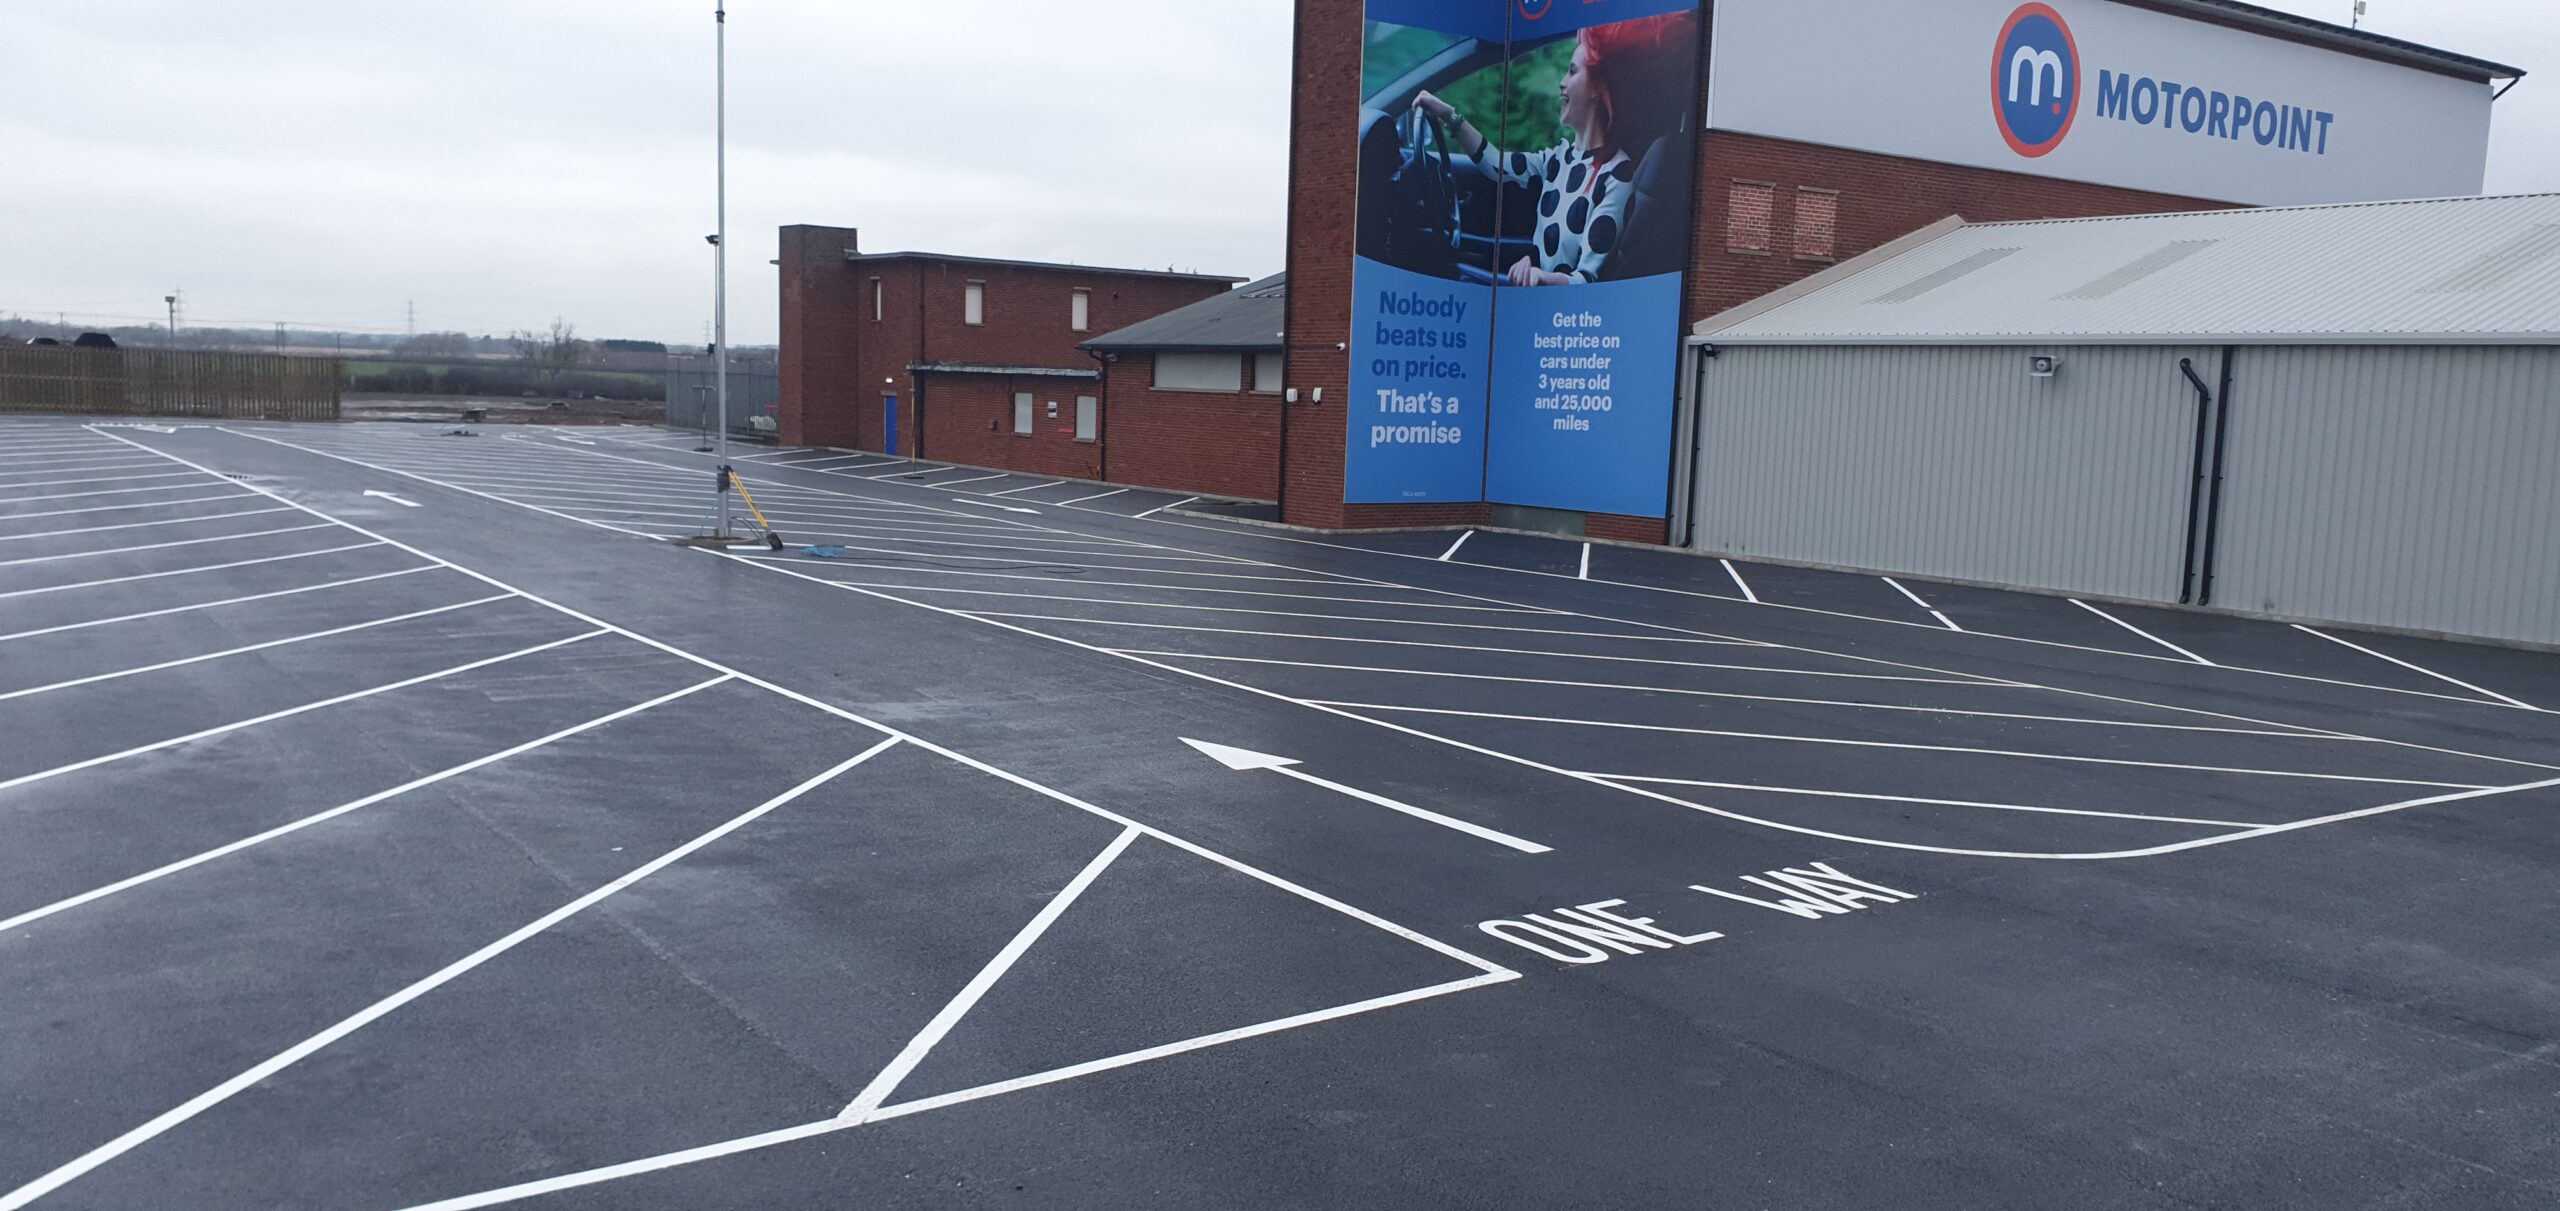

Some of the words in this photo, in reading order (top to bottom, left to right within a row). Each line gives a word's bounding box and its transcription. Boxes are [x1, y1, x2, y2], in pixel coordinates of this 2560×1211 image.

[2096, 68, 2333, 155] MOTORPOINT
[1379, 290, 1467, 324] Nobody
[1552, 311, 1577, 328] Get
[1578, 310, 1602, 328] the
[1375, 320, 1438, 348] beats
[1441, 330, 1467, 349] us
[1533, 332, 1562, 349] best
[1563, 331, 1600, 352] price
[1601, 335, 1620, 349] on
[1371, 358, 1400, 377] on
[1404, 354, 1466, 382] price.
[1540, 356, 1568, 370] cars
[1570, 352, 1611, 370] under
[1538, 373, 1548, 389] 3
[1549, 377, 1585, 393] years
[1587, 373, 1611, 390] old
[1376, 388, 1442, 414] That's
[1446, 396, 1459, 415] a
[1534, 393, 1559, 410] and
[1560, 394, 1613, 412] 25,000
[1371, 420, 1461, 448] promise
[1553, 414, 1590, 431] miles
[1478, 898, 1726, 965] ONE
[1687, 861, 1918, 920] WAY
